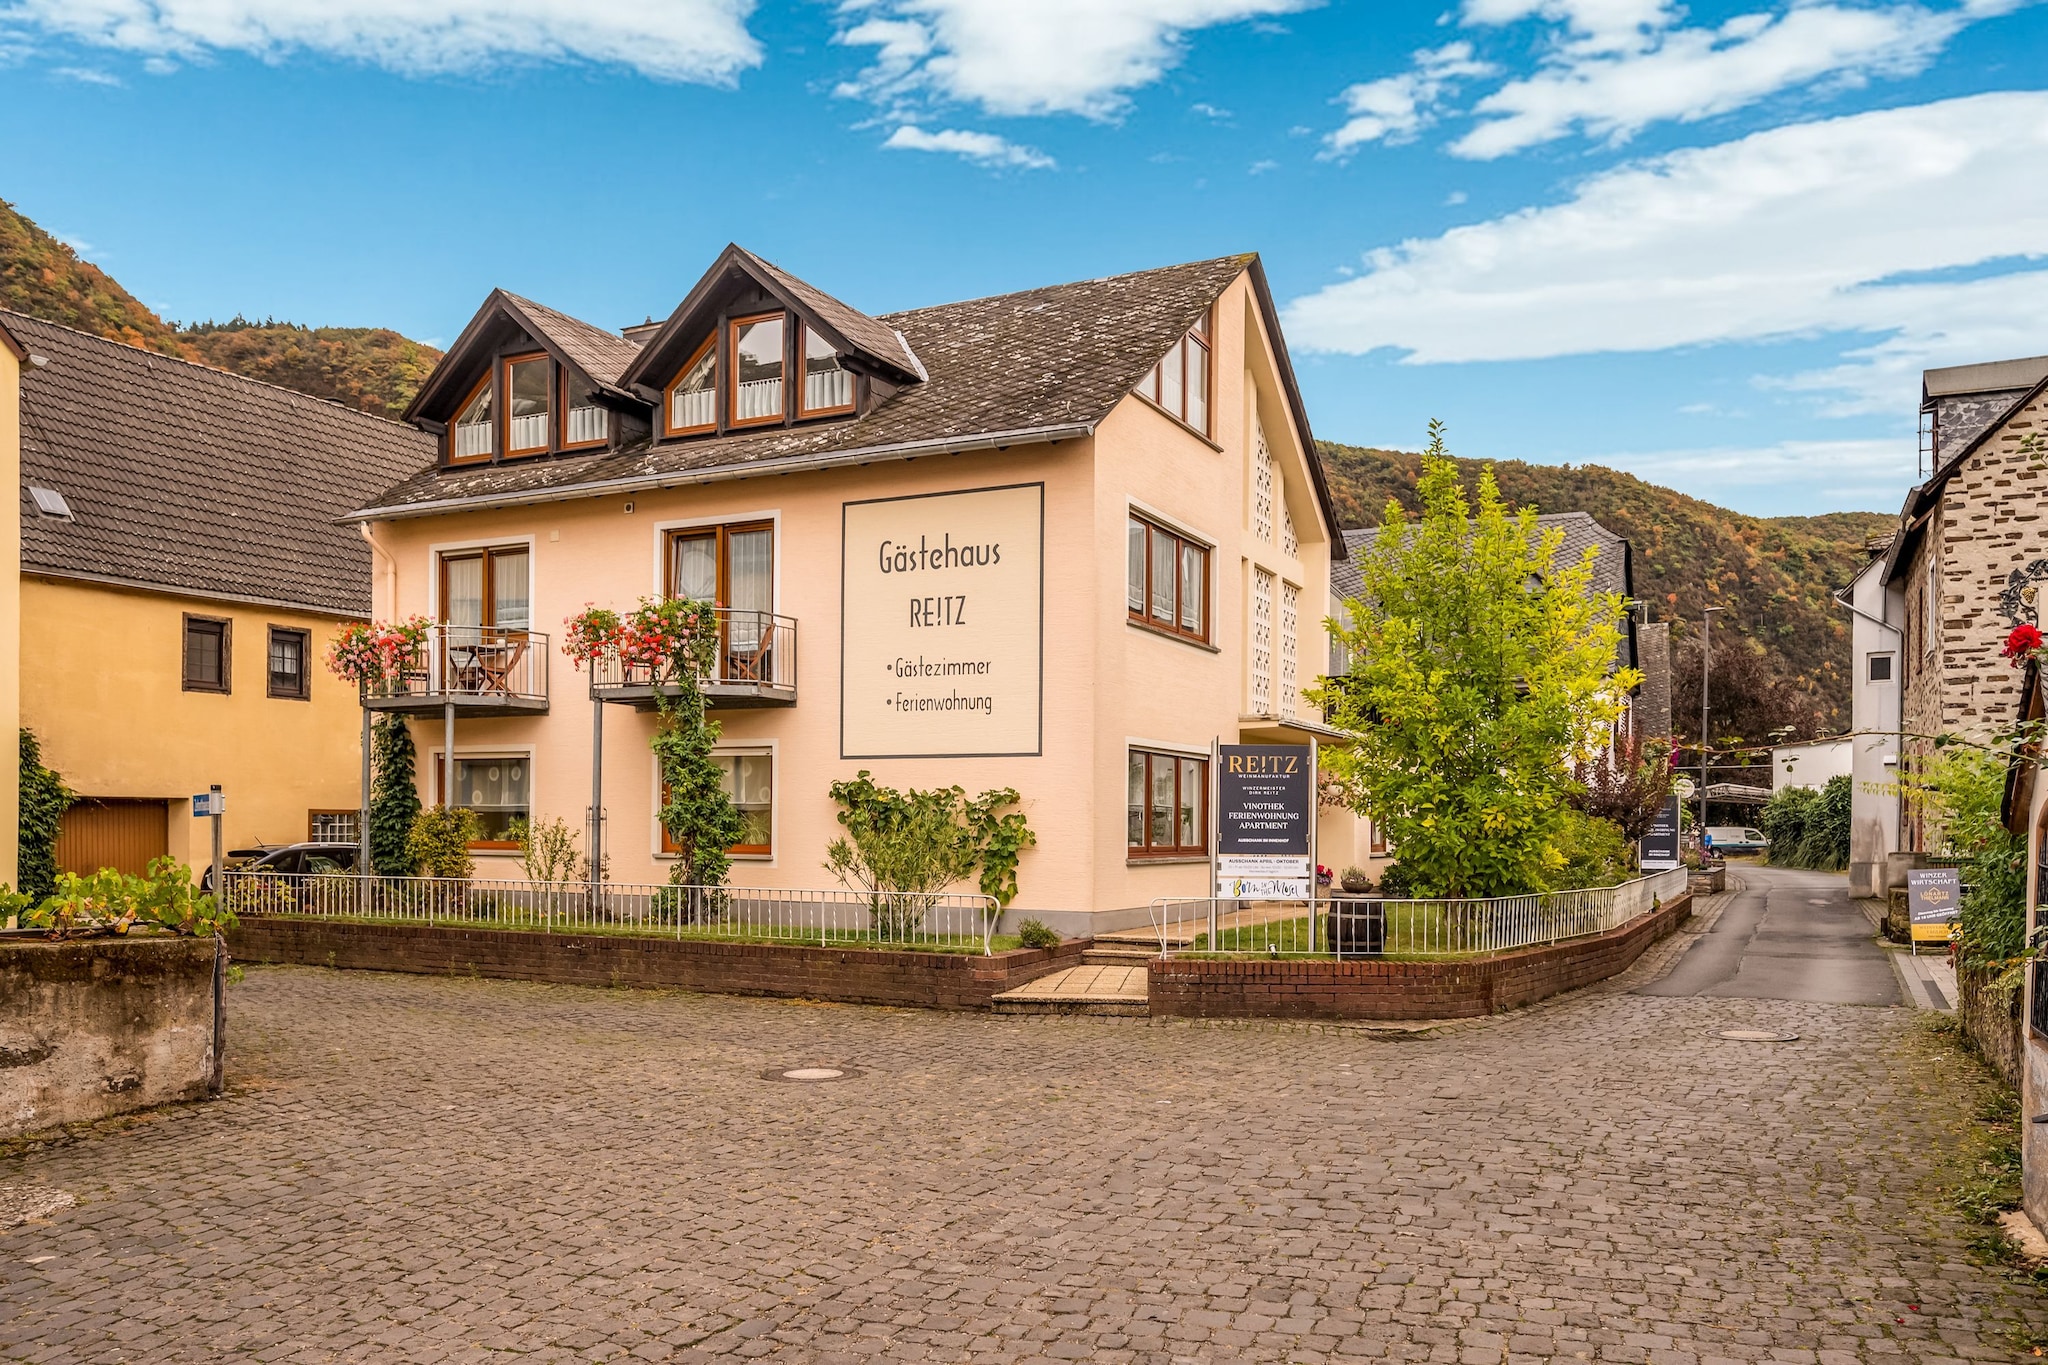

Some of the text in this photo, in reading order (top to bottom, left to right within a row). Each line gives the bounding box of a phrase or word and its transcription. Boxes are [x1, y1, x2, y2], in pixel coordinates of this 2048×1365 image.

[879, 533, 1001, 574] Gästehaus
[895, 655, 992, 678] Gästezimmer
[895, 689, 993, 715] Ferienwohnung
[1243, 802, 1285, 810] VINOTHEK
[1228, 812, 1299, 820] FERIENWOHNUNG
[1238, 822, 1289, 830] APARTMENT
